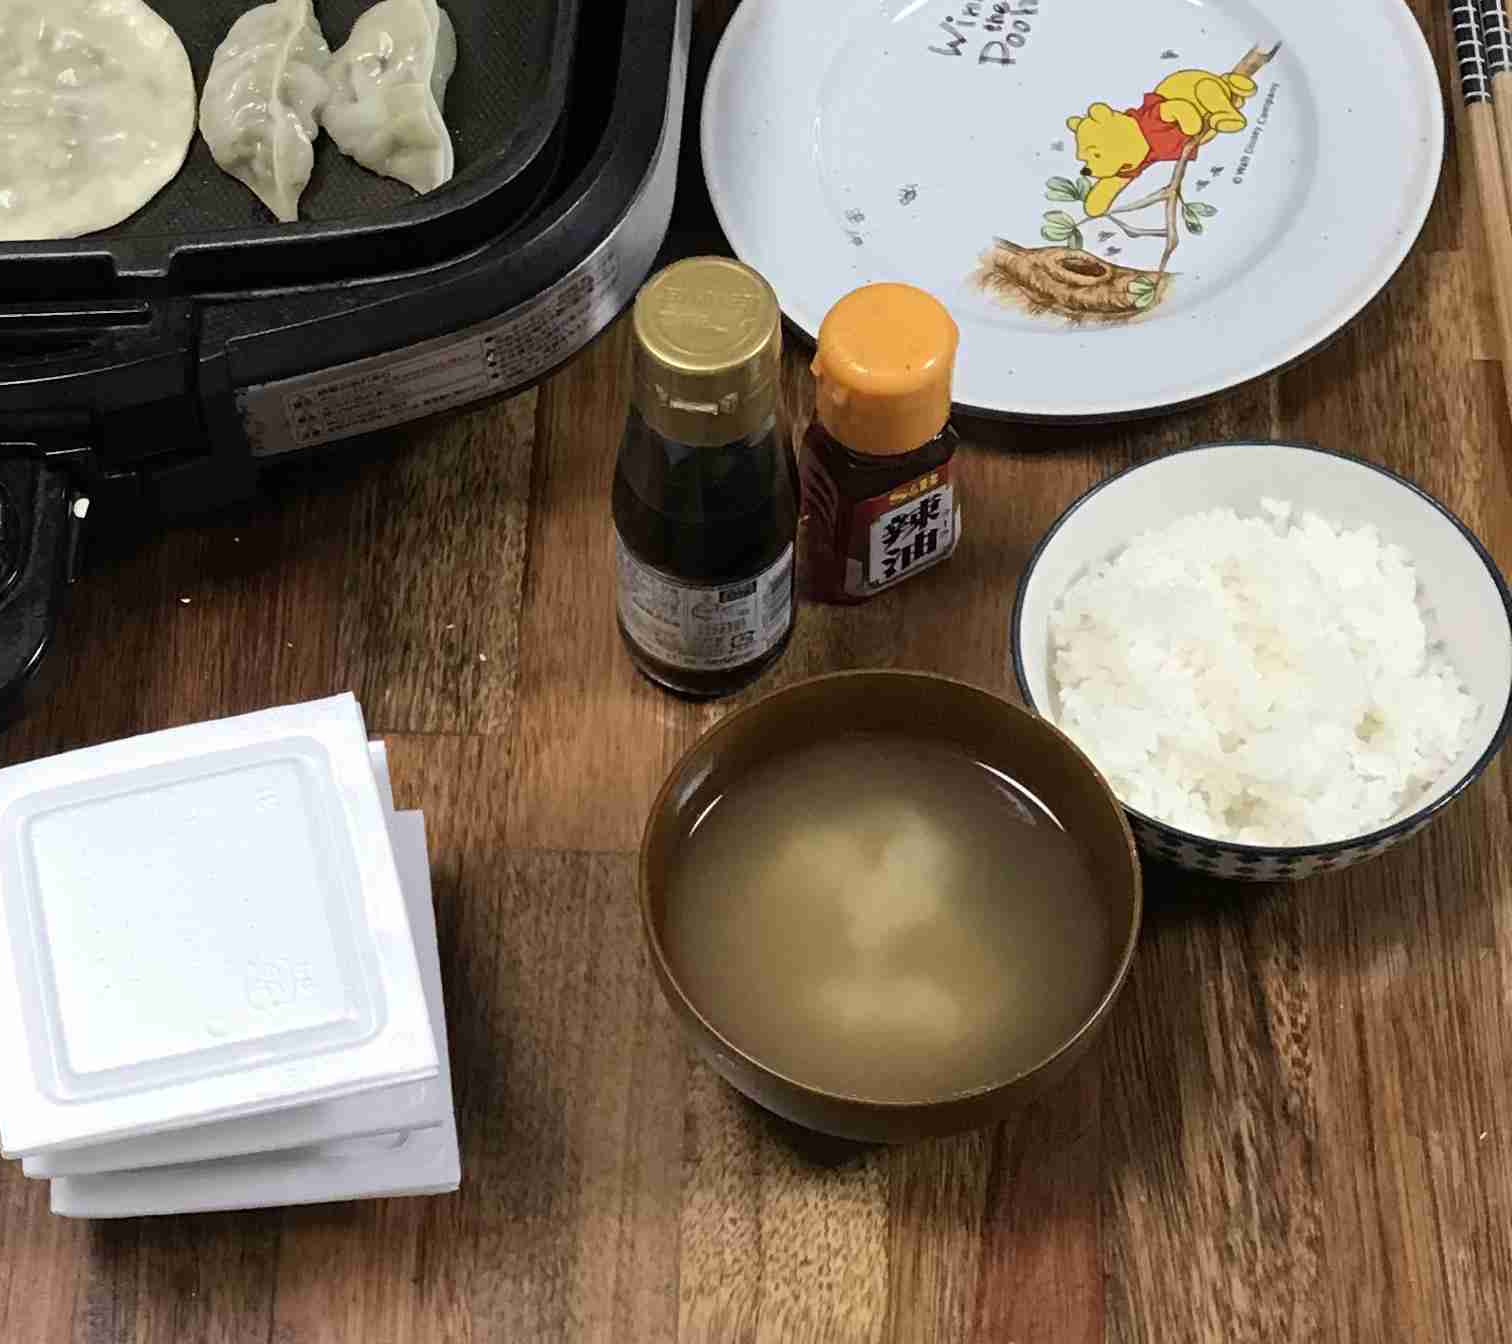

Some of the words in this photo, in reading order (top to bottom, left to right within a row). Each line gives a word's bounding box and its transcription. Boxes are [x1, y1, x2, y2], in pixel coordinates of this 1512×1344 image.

[978, 0, 1040, 65] Pooh
[983, 1, 1010, 32] the
[1256, 82, 1280, 125] Company
[881, 493, 942, 578] 辣油
